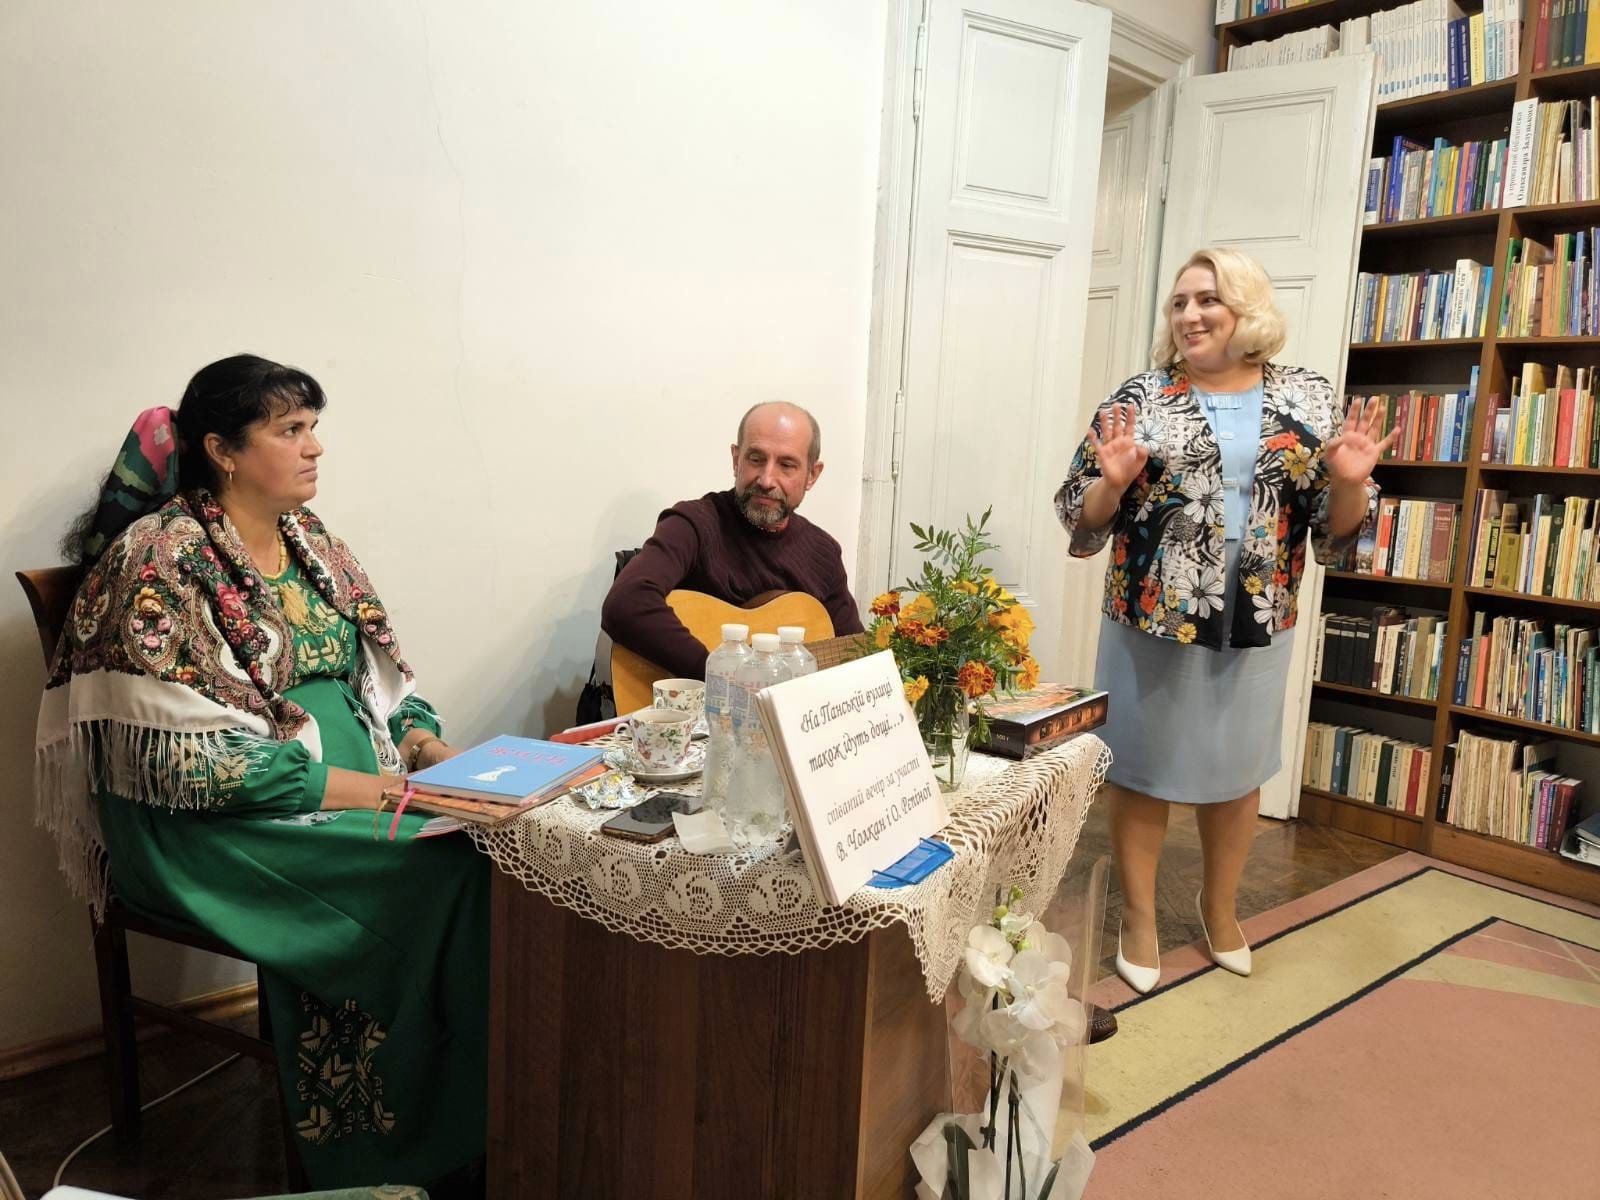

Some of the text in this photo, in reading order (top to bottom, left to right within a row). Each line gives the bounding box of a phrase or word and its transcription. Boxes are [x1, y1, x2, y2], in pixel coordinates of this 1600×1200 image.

[819, 690, 866, 725] Панській
[865, 676, 893, 708] вулиці
[808, 743, 848, 773] також
[842, 732, 870, 757] ідуть
[826, 753, 921, 826] співаний вечір за участі
[836, 841, 849, 862] В.
[846, 818, 887, 851] Чолкан
[890, 804, 902, 822] О.
[900, 782, 932, 815] Репіної
